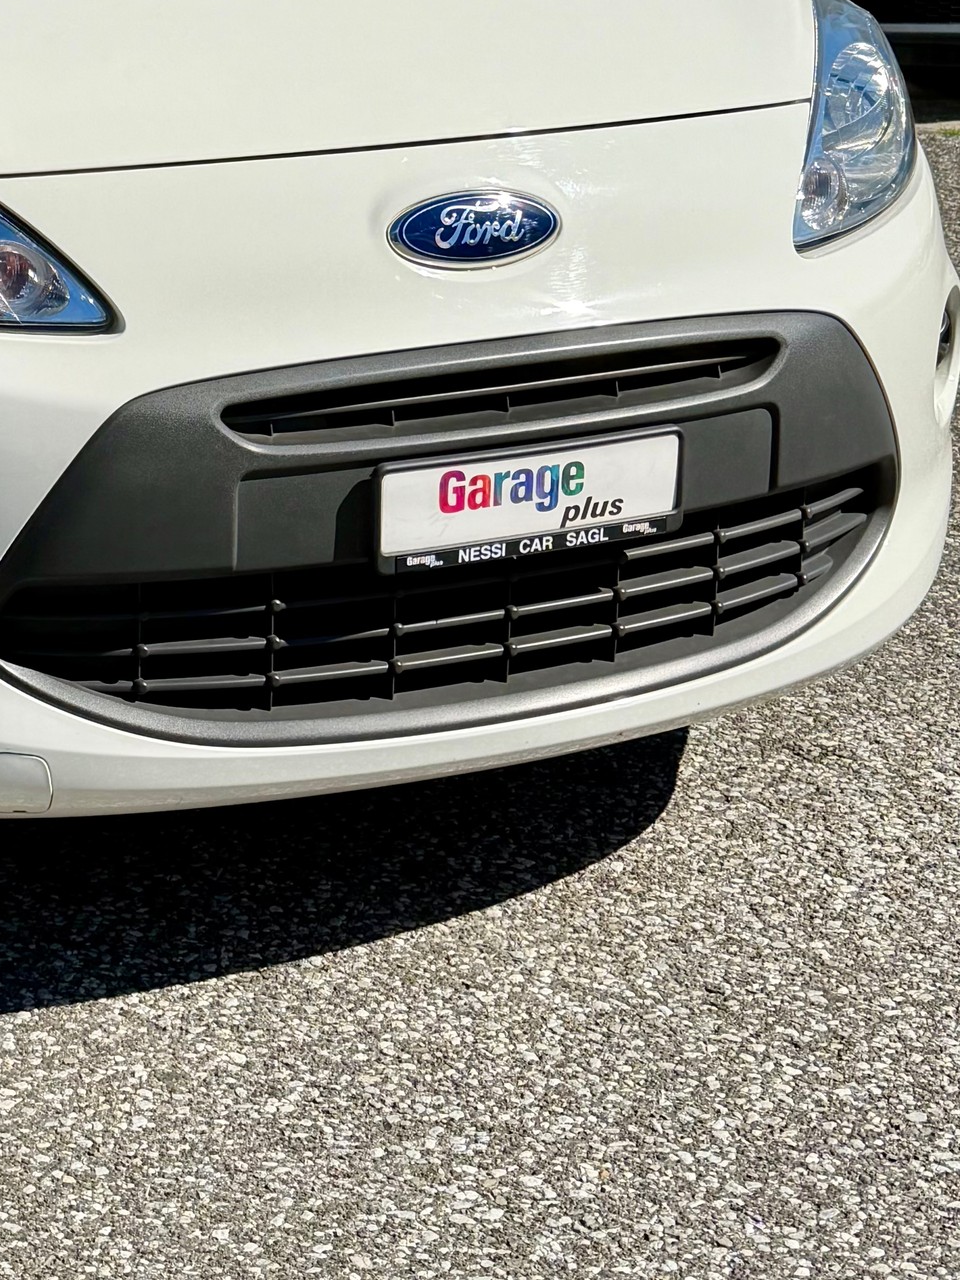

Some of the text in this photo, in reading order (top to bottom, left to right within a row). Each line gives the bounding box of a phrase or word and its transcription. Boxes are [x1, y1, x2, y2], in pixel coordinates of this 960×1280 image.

[434, 199, 525, 249] Ford
[438, 459, 586, 514] Garage
[559, 494, 625, 529] plus
[622, 521, 651, 534] Garage
[406, 553, 436, 567] Garage
[457, 527, 610, 564] NESSI CAR SAGL
